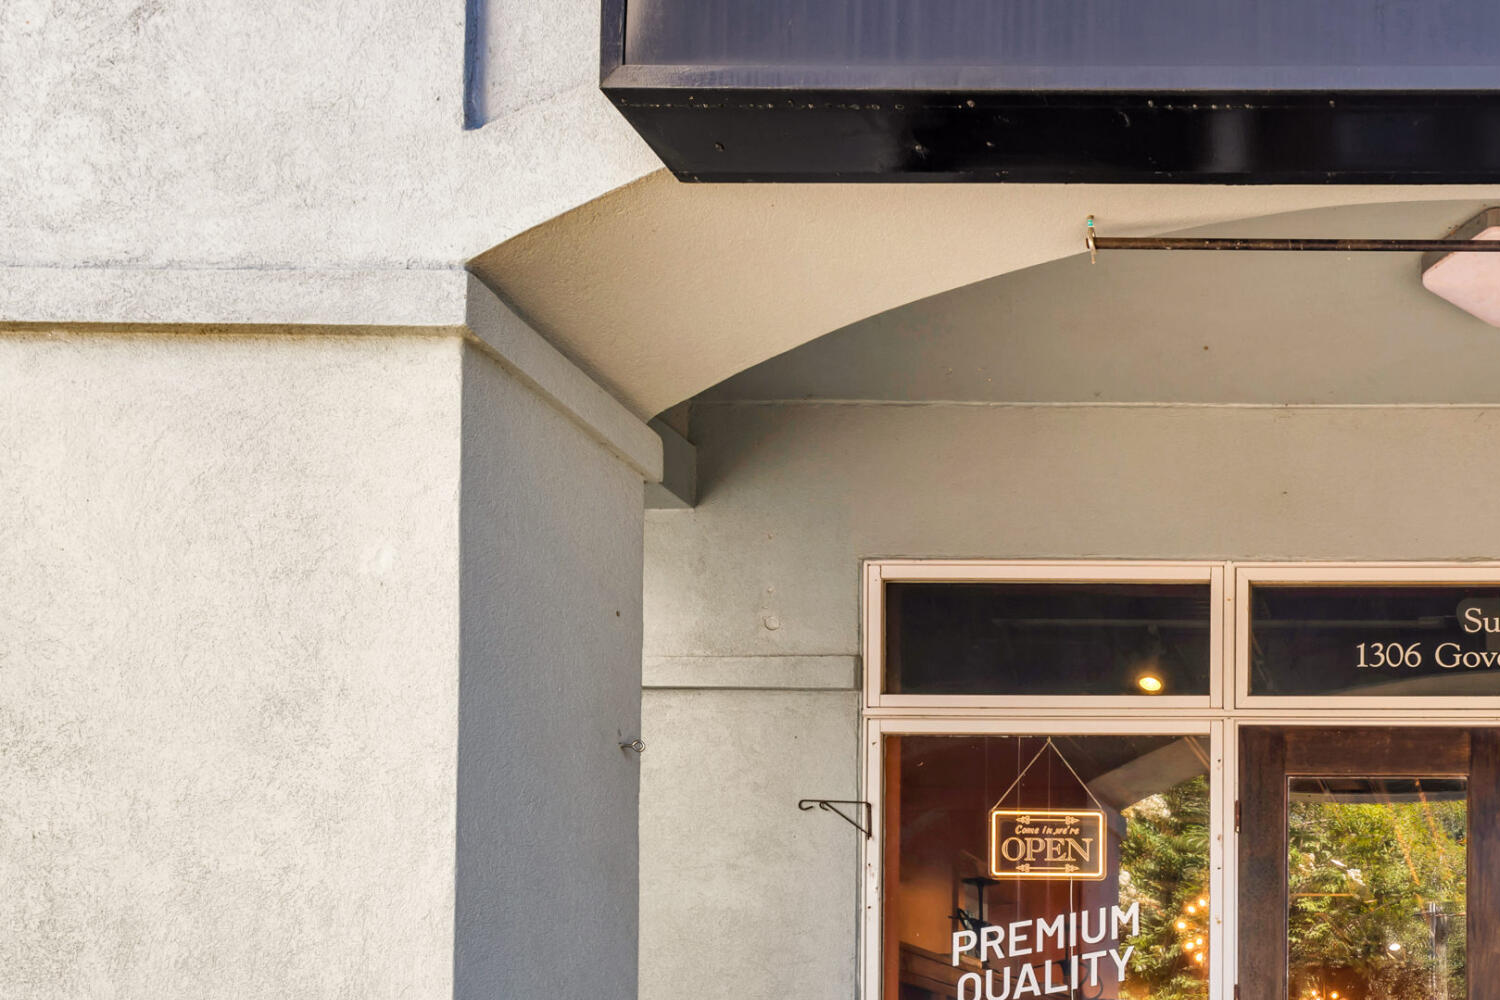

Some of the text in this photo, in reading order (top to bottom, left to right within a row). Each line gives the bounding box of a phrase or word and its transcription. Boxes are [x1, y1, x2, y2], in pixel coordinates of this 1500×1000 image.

[1355, 642, 1422, 669] 1306
[1014, 824, 1040, 835] Come
[1001, 836, 1094, 862] OPEN
[951, 901, 1140, 967] PREMIUM
